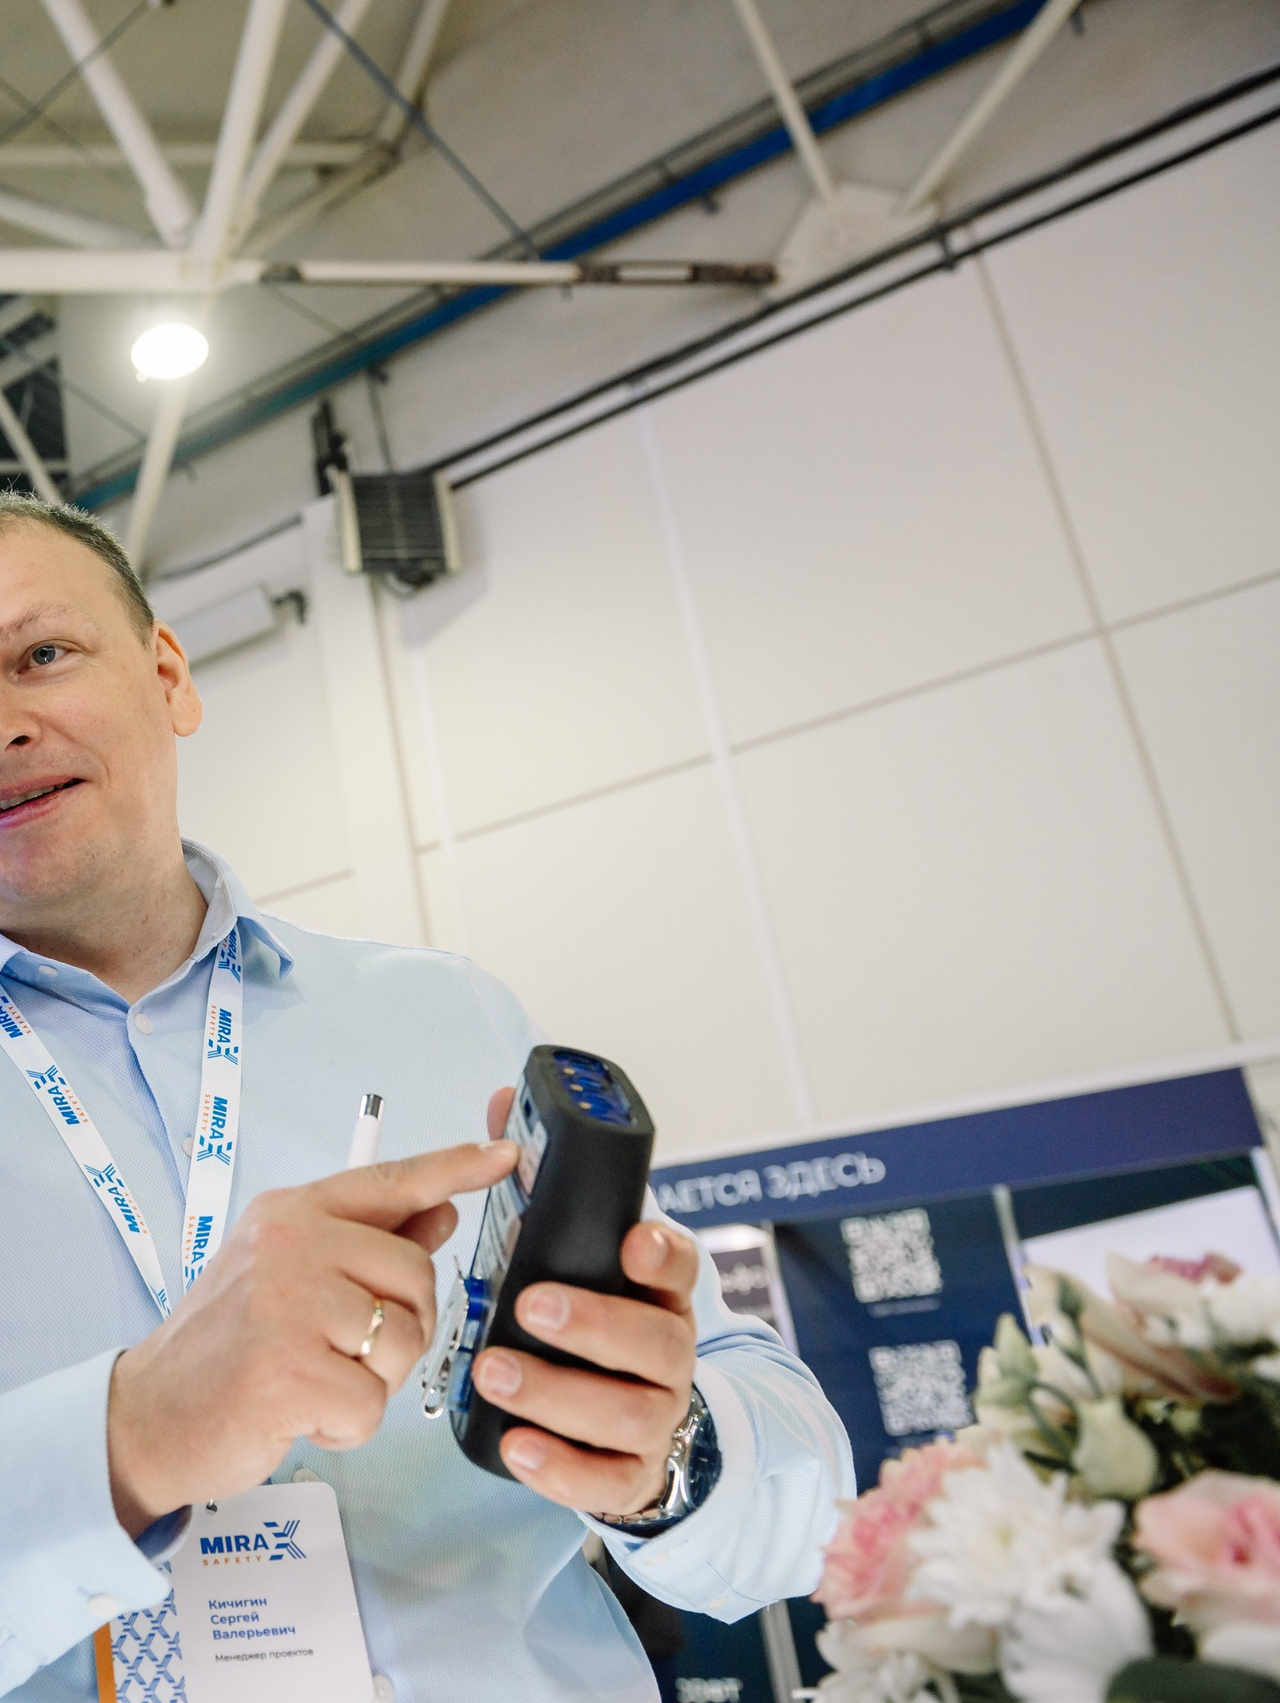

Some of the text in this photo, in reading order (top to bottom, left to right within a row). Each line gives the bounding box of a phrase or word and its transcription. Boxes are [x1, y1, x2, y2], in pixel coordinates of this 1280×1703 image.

[7, 1005, 32, 1035] SAFETY
[208, 1004, 217, 1037] SAFETY
[64, 1088, 90, 1124] SAFETY
[201, 1093, 211, 1132] SAFETY
[654, 1169, 763, 1213] АЕТСЯ
[184, 1215, 196, 1260] SAFETY
[202, 1555, 262, 1566] SAFETY
[208, 1598, 268, 1610] Кичигин
[210, 1611, 260, 1626] Сергей
[212, 1625, 296, 1641] Валерьевич
[214, 1648, 314, 1663] Менеджер проектов
